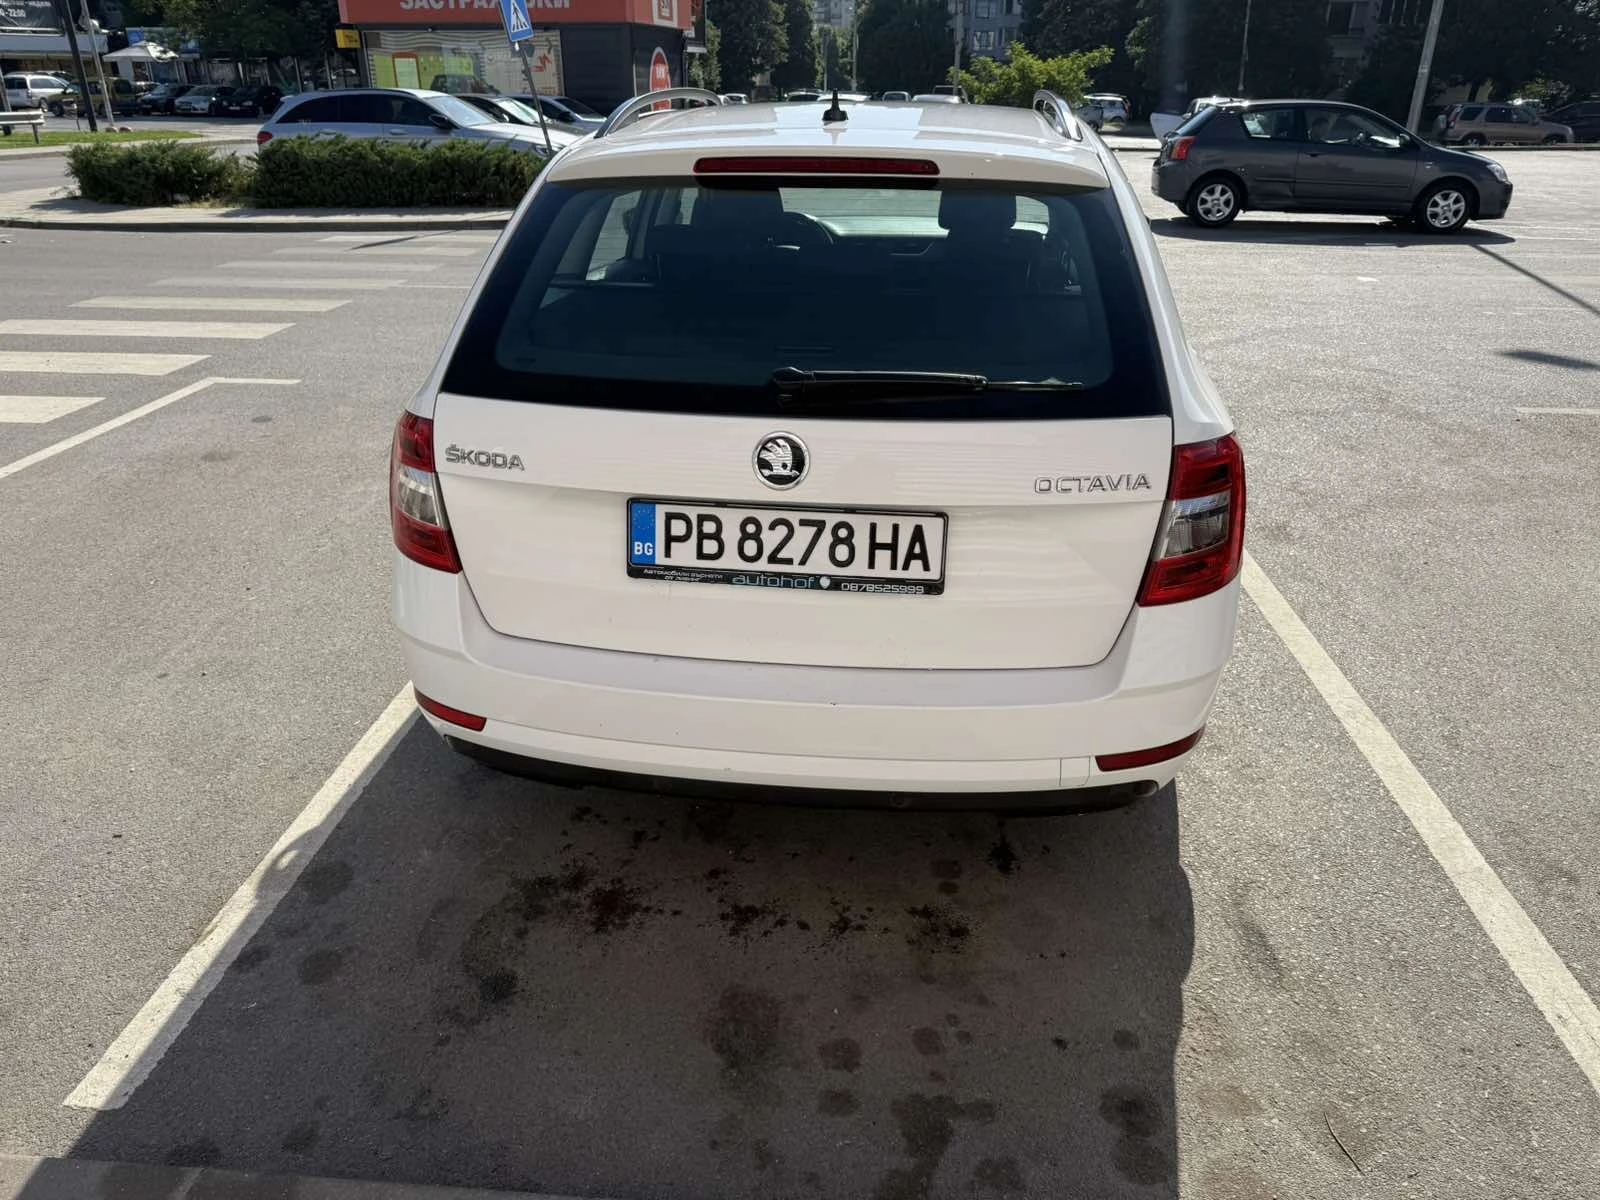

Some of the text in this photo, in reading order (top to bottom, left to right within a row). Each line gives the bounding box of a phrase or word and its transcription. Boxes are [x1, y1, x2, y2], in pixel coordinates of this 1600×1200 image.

[446, 443, 525, 471] ŠKODA
[1034, 473, 1151, 494] OCTAVIA
[634, 541, 653, 556] BG
[664, 511, 931, 572] PB 8278 HA
[732, 574, 815, 590] autohof
[841, 582, 925, 594] 0878525999
